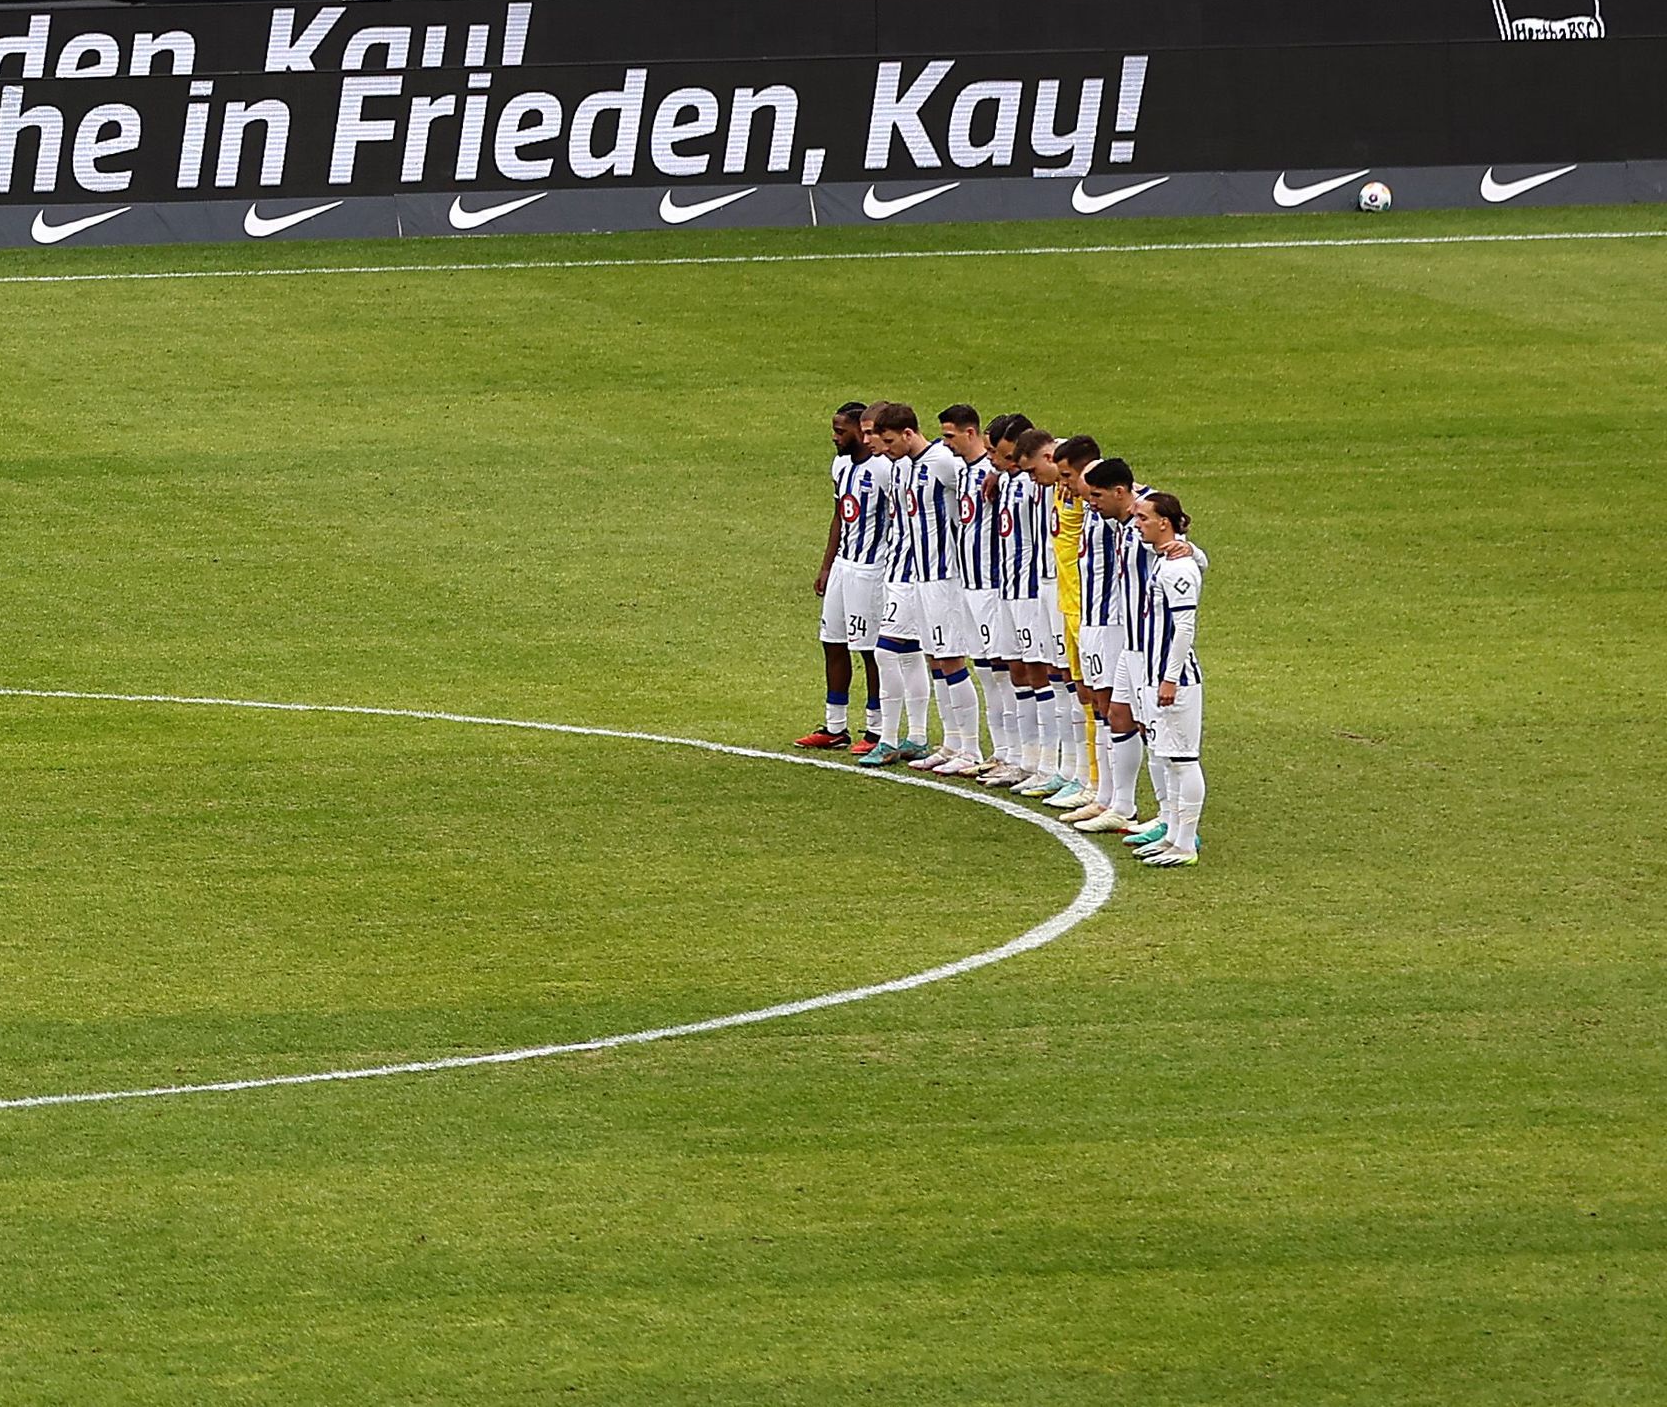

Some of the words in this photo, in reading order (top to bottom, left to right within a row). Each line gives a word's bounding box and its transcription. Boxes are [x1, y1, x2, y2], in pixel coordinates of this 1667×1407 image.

[175, 79, 293, 190] in
[327, 67, 827, 186] Frieden,
[864, 54, 1150, 178] Kay!
[847, 614, 867, 637] 34
[980, 624, 990, 645] 9
